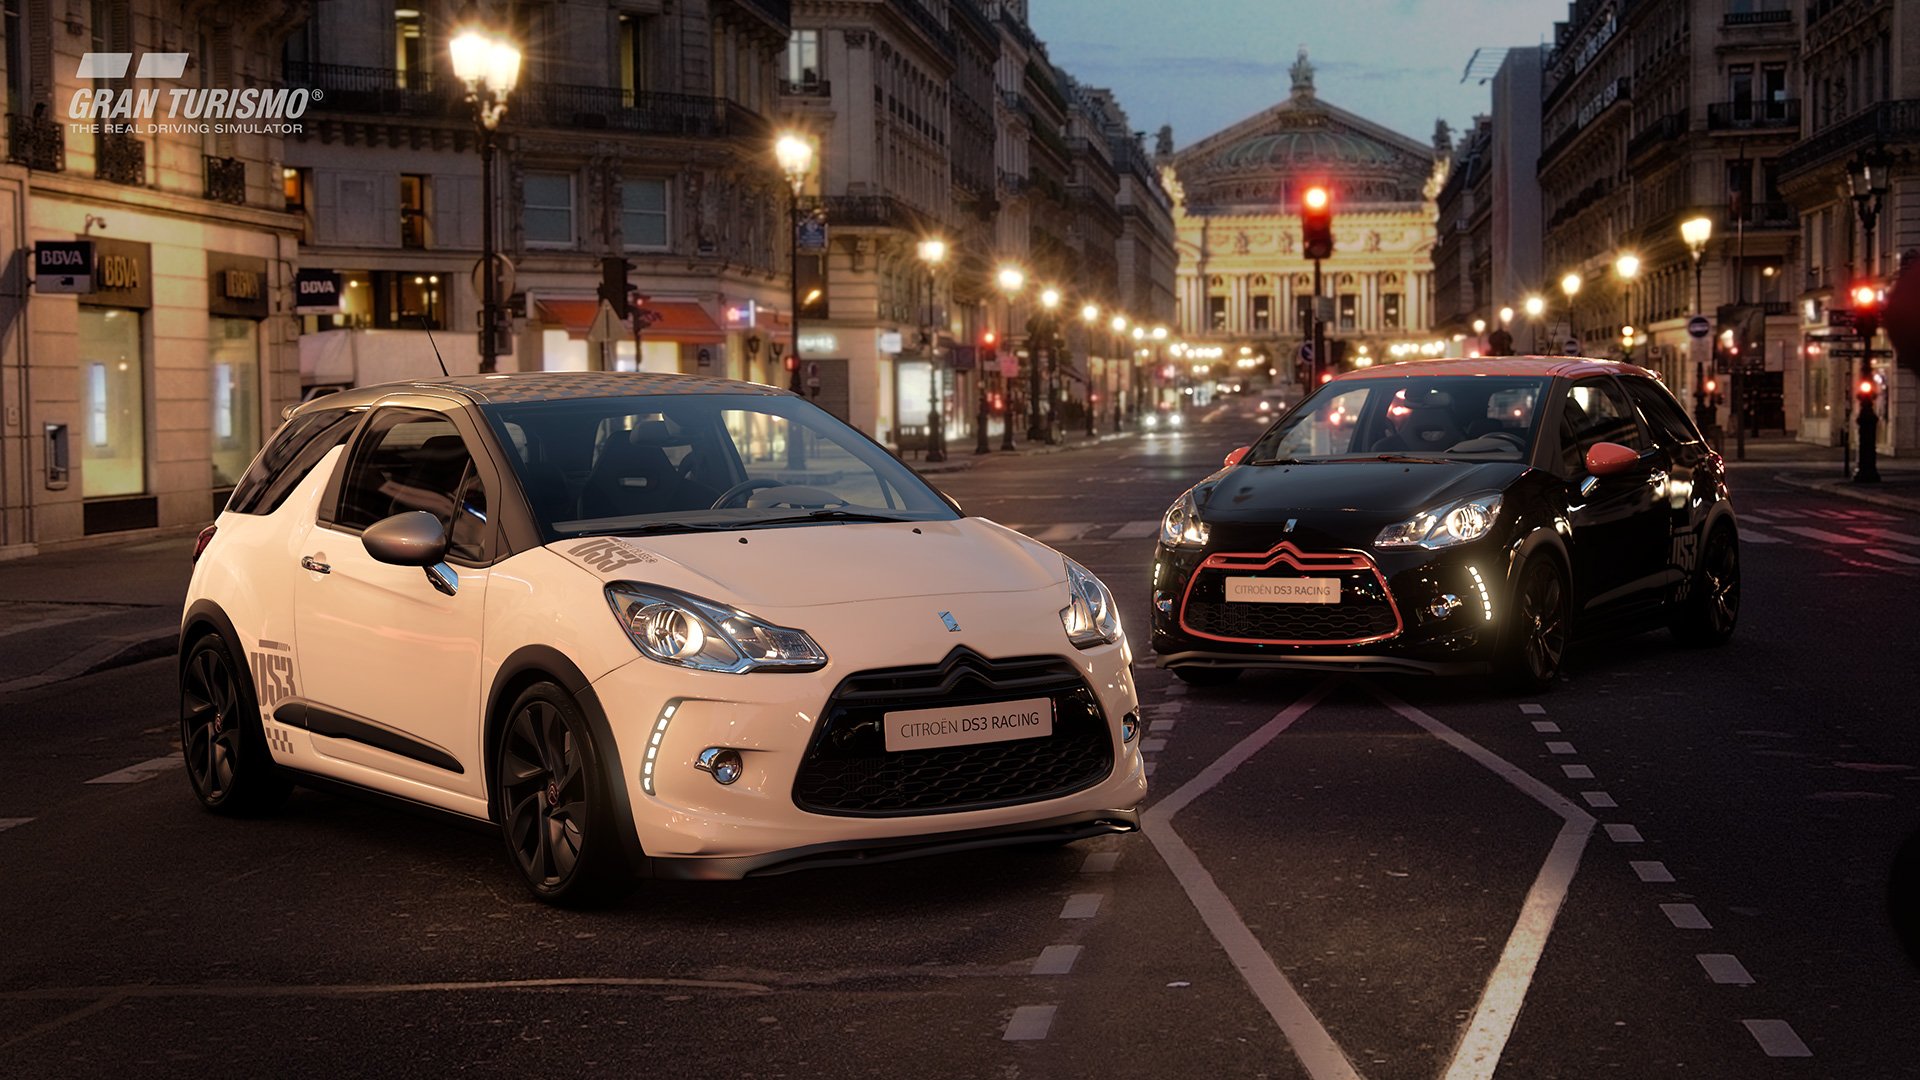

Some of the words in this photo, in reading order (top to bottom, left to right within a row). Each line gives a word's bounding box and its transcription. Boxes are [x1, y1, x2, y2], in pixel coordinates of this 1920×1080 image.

[41, 250, 83, 265] BBVA
[104, 255, 140, 289] BBVA
[301, 281, 335, 293] BBVA
[567, 538, 643, 573] DS3
[1234, 583, 1272, 595] CITROËN
[1274, 585, 1292, 595] DS3
[1295, 585, 1331, 596] RACING
[250, 651, 297, 707] DS3
[900, 717, 959, 738] CITROËN
[962, 717, 988, 732] DS3
[992, 712, 1040, 729] RACING
